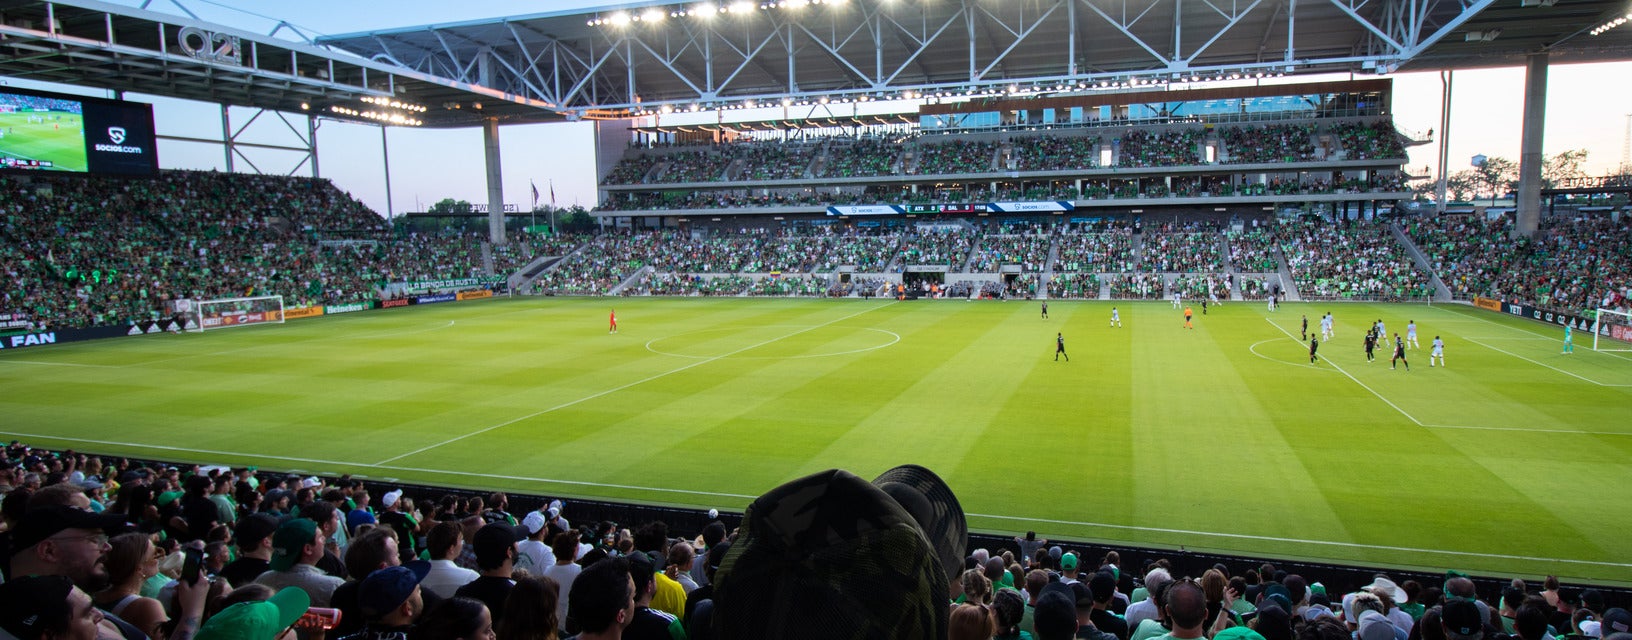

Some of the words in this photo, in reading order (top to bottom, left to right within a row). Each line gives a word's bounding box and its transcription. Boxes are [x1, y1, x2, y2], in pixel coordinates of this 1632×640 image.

[326, 304, 363, 314] Heineken
[1509, 304, 1522, 316] YETI
[11, 332, 56, 347] FAN
